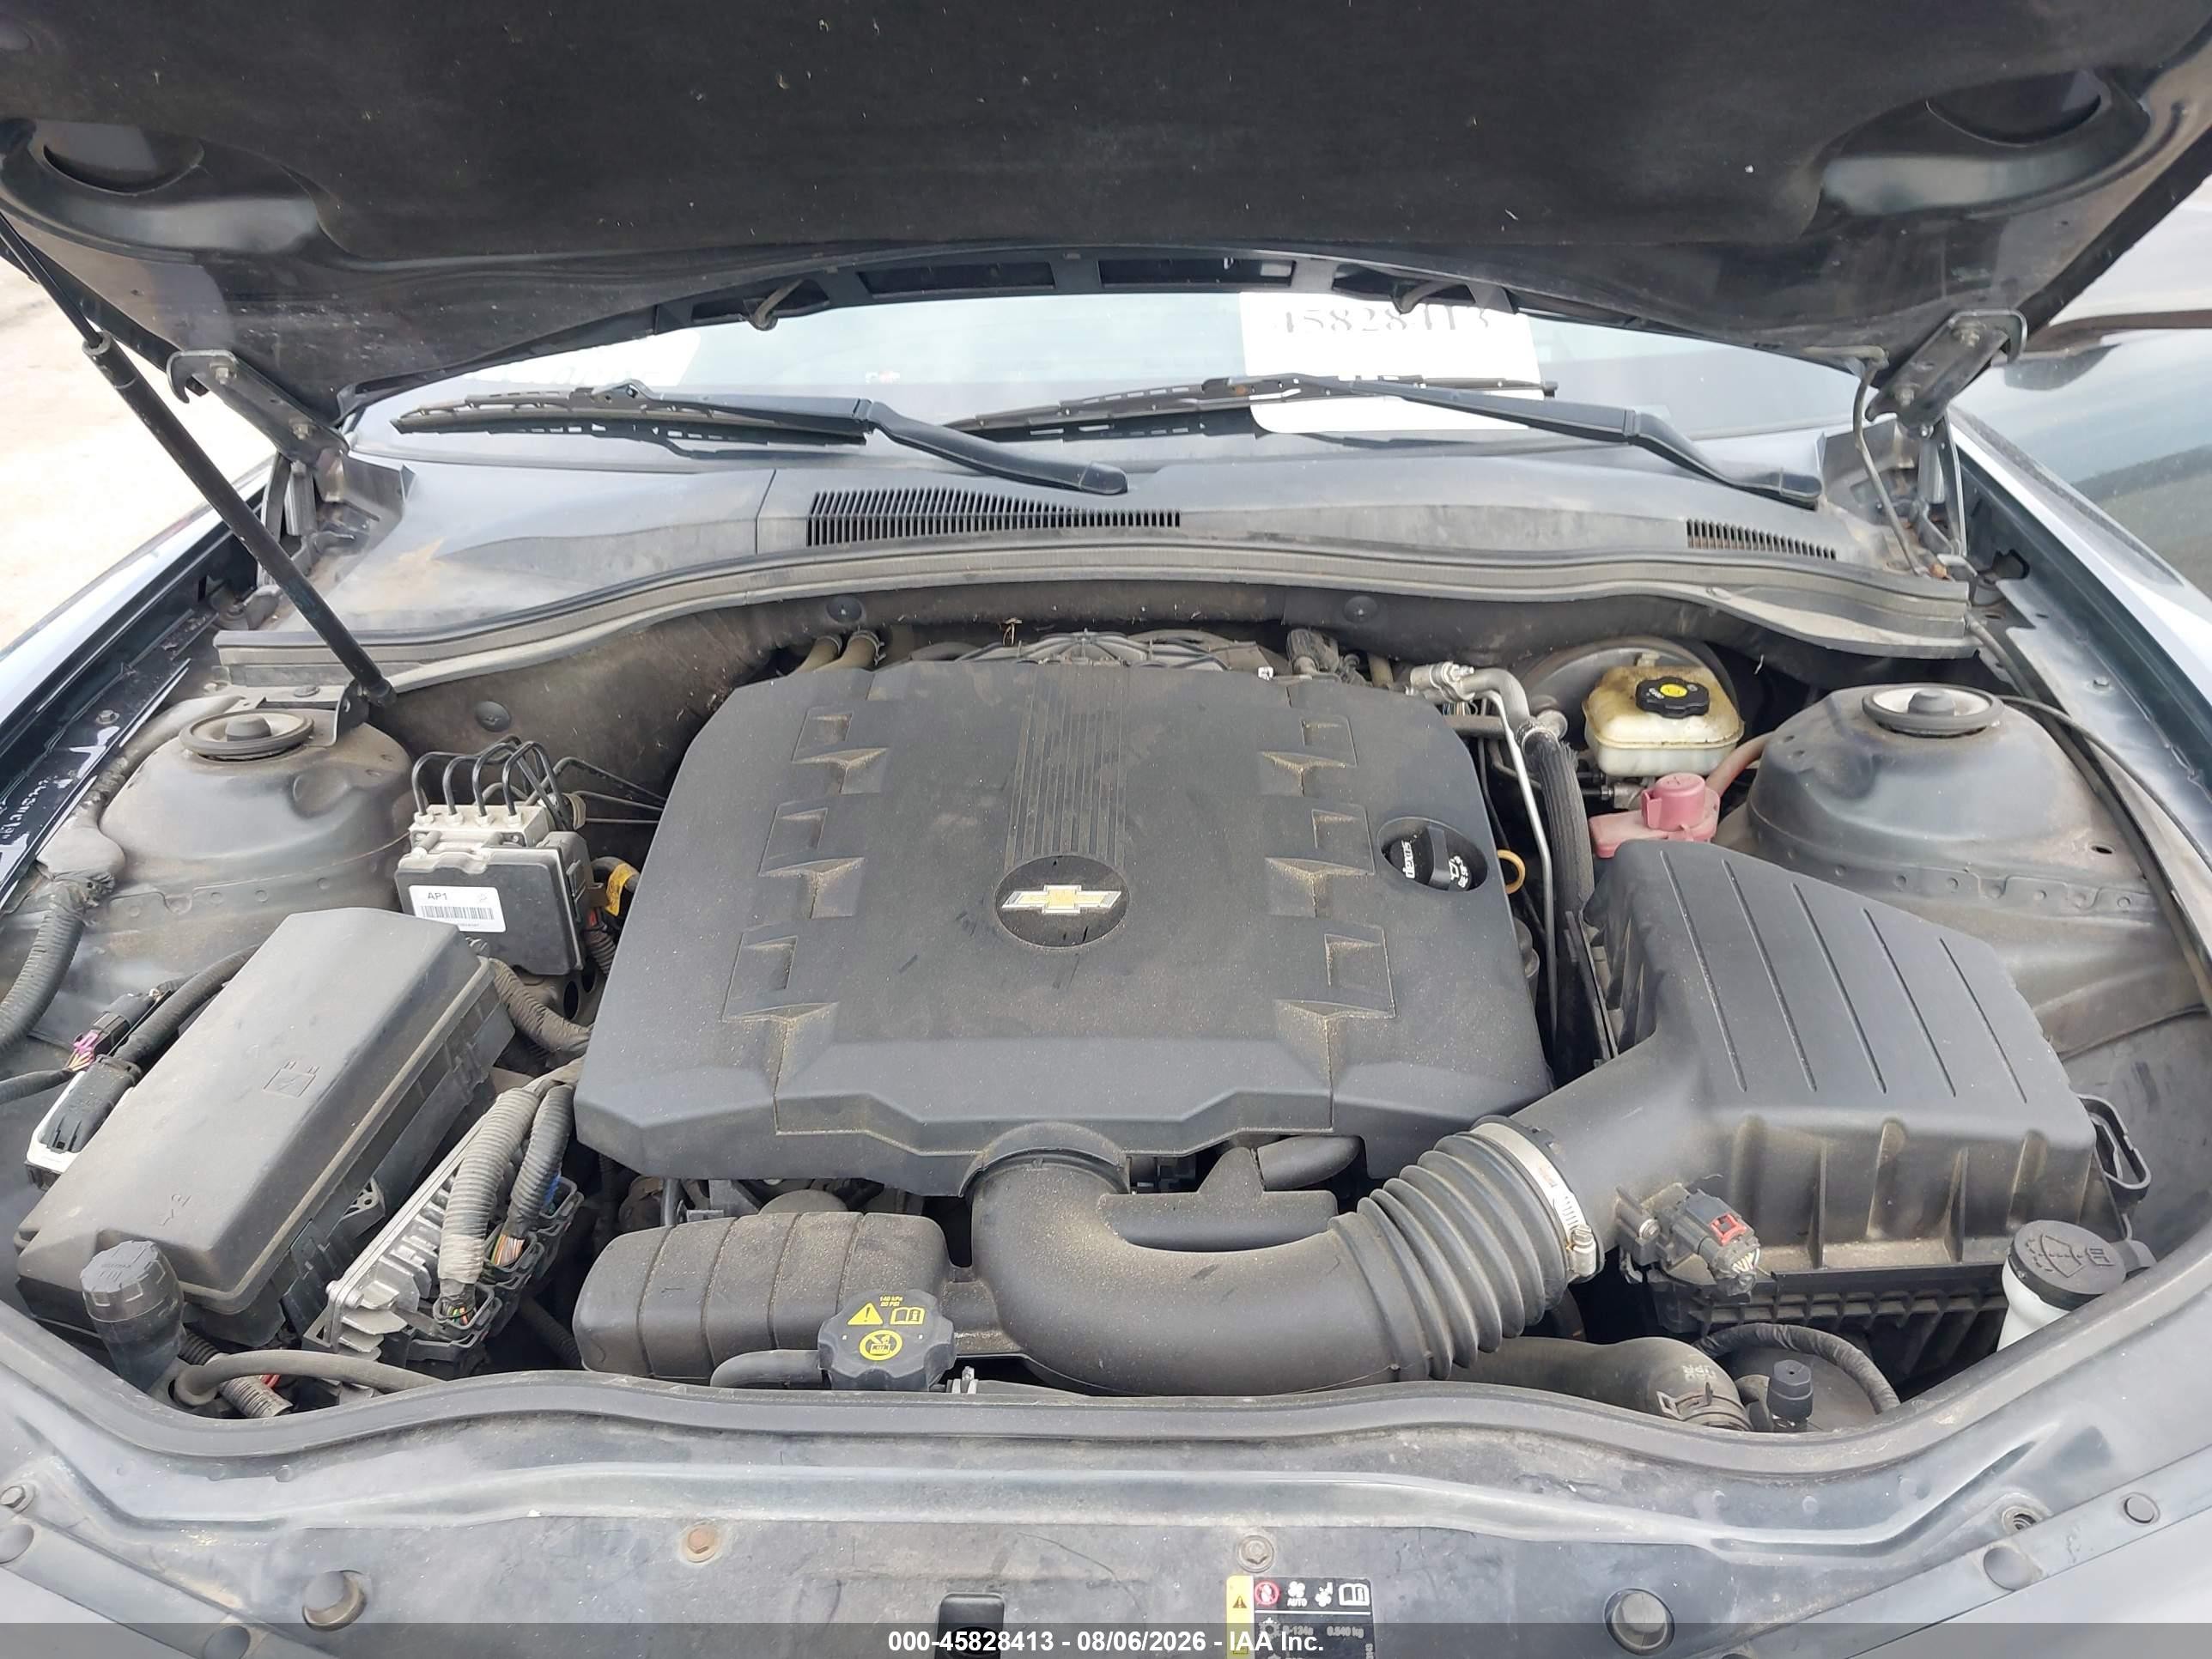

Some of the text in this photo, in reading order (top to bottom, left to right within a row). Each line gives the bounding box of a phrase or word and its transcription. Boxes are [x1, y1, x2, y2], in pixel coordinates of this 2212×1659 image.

[1401, 840, 1416, 879] dexos
[428, 892, 447, 901] AP1
[1287, 1597, 1308, 1607] AUTO
[1352, 1626, 1364, 1639] kg
